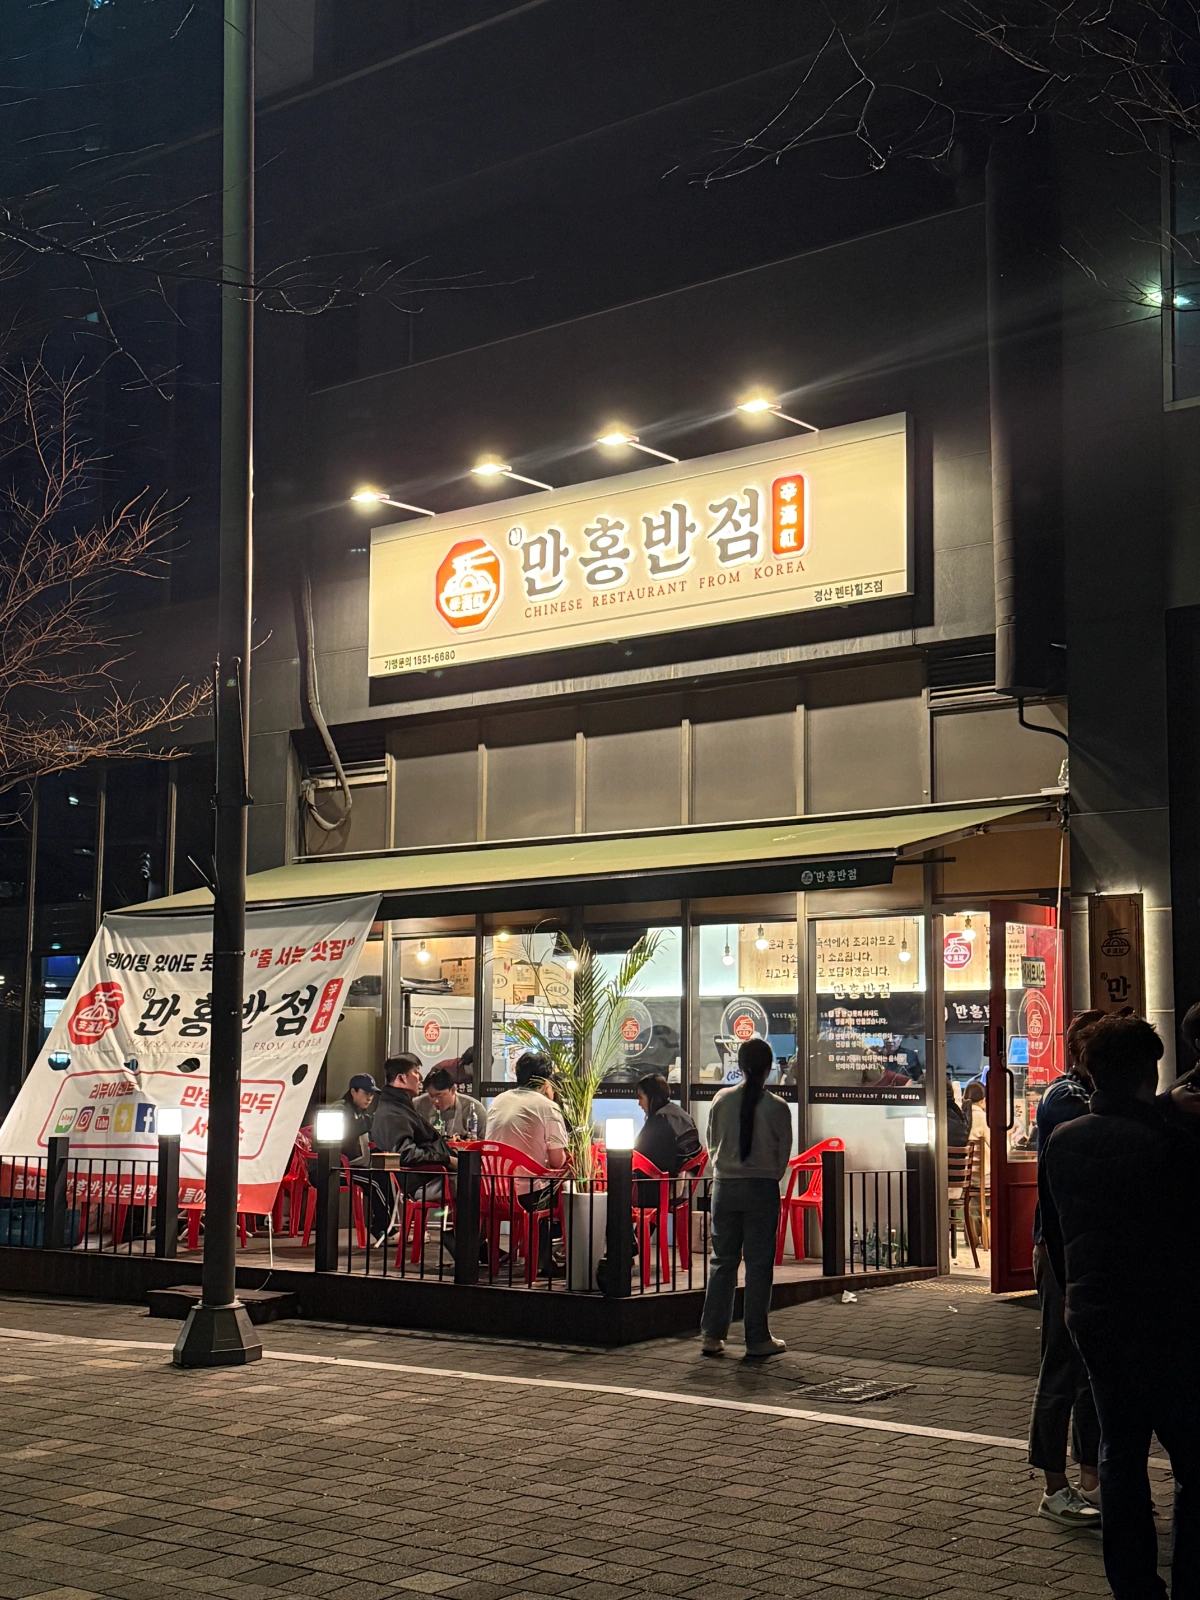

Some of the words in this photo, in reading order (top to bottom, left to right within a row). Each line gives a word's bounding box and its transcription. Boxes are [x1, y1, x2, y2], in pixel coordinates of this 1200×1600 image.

[524, 598, 583, 619] CHINESE
[592, 580, 688, 608] RESTAURANT
[699, 571, 741, 589] FROM
[754, 560, 806, 580] KOREA
[814, 587, 832, 603] 경산
[835, 579, 883, 599] 펜타힐즈점
[384, 656, 411, 670] 가맹문의
[413, 650, 456, 666] 1551-6680
[815, 868, 857, 883] 만홍반점
[853, 935, 896, 947] 조리하므로
[106, 952, 151, 973] 웨이팅
[152, 953, 197, 973] 있어도
[275, 945, 302, 967] 서는
[956, 1003, 990, 1020] 만홍
[253, 1042, 285, 1050] FROM
[292, 1037, 323, 1048] KOREA
[89, 1081, 136, 1099] 리뷰이벤트
